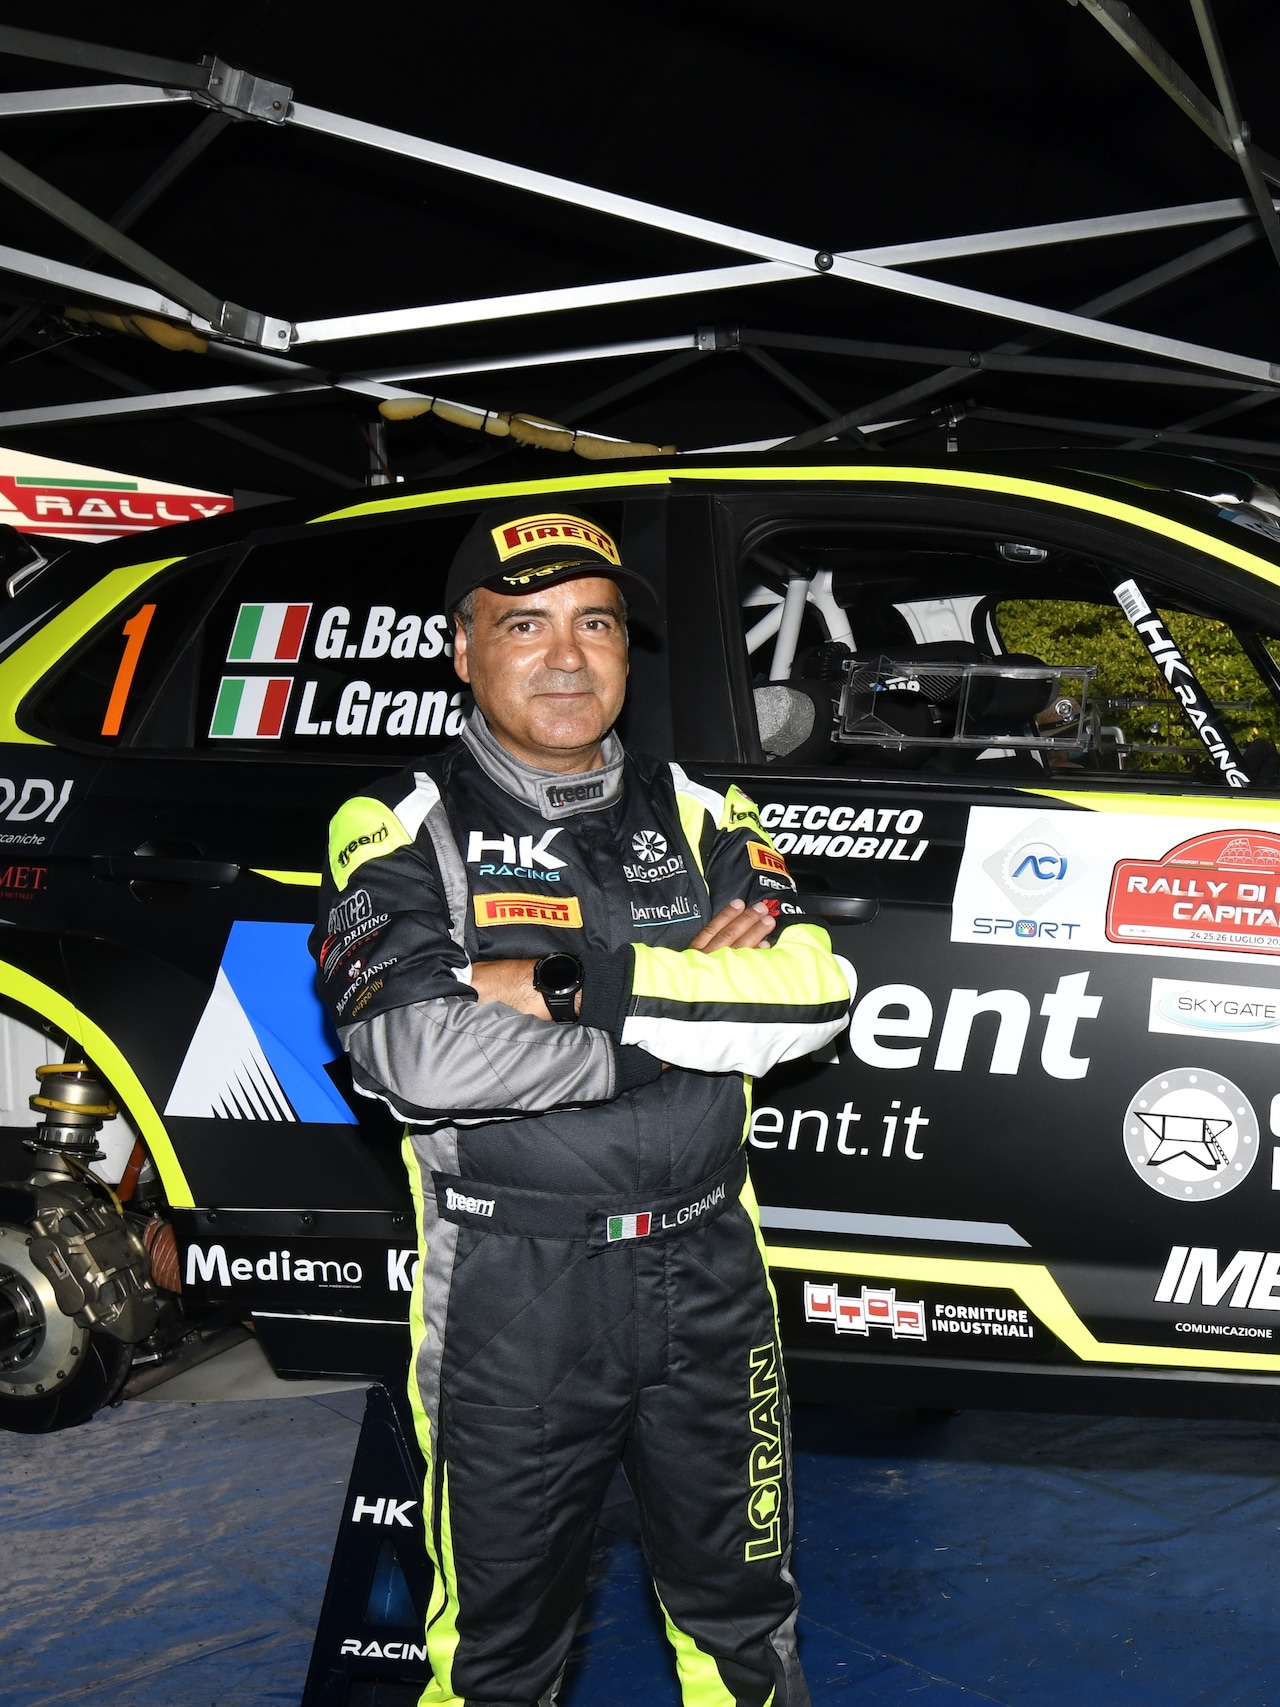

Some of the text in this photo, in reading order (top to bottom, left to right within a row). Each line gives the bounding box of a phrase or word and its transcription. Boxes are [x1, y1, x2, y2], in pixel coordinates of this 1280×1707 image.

[35, 496, 227, 521] RALLY
[502, 518, 615, 558] PIRELLI
[315, 606, 453, 660] G.Bas
[101, 604, 157, 736] 1
[295, 680, 468, 737] L.Grana
[1137, 619, 1250, 788] HK RACING
[546, 780, 604, 807] freem
[760, 803, 924, 834] CECCATO
[338, 822, 388, 868] freem
[467, 827, 568, 870] HK
[478, 863, 560, 882] RACING
[1012, 855, 1068, 880] ACI
[1127, 875, 1229, 898] RALLY
[1237, 883, 1266, 903] DI
[485, 900, 569, 921] PIRELLI
[344, 912, 389, 947] DRIVING
[972, 918, 1081, 940] SPORT
[1190, 931, 1227, 943] 24.25.26
[1229, 934, 1265, 945] LUGLIO
[1178, 996, 1276, 1019] SKYGATE
[749, 1100, 930, 1160] ent.it
[446, 1187, 495, 1217] freem
[661, 1183, 726, 1229] L.GRANAI
[186, 1243, 363, 1287] Mediamo
[932, 1318, 1034, 1338] INDUSTRIALI
[935, 1303, 1029, 1323] FORNITURE
[1175, 1322, 1273, 1339] COMUNICAZIONE
[744, 1341, 785, 1563] LORAN
[351, 1496, 419, 1528] HK
[340, 1638, 428, 1663] RACIN
